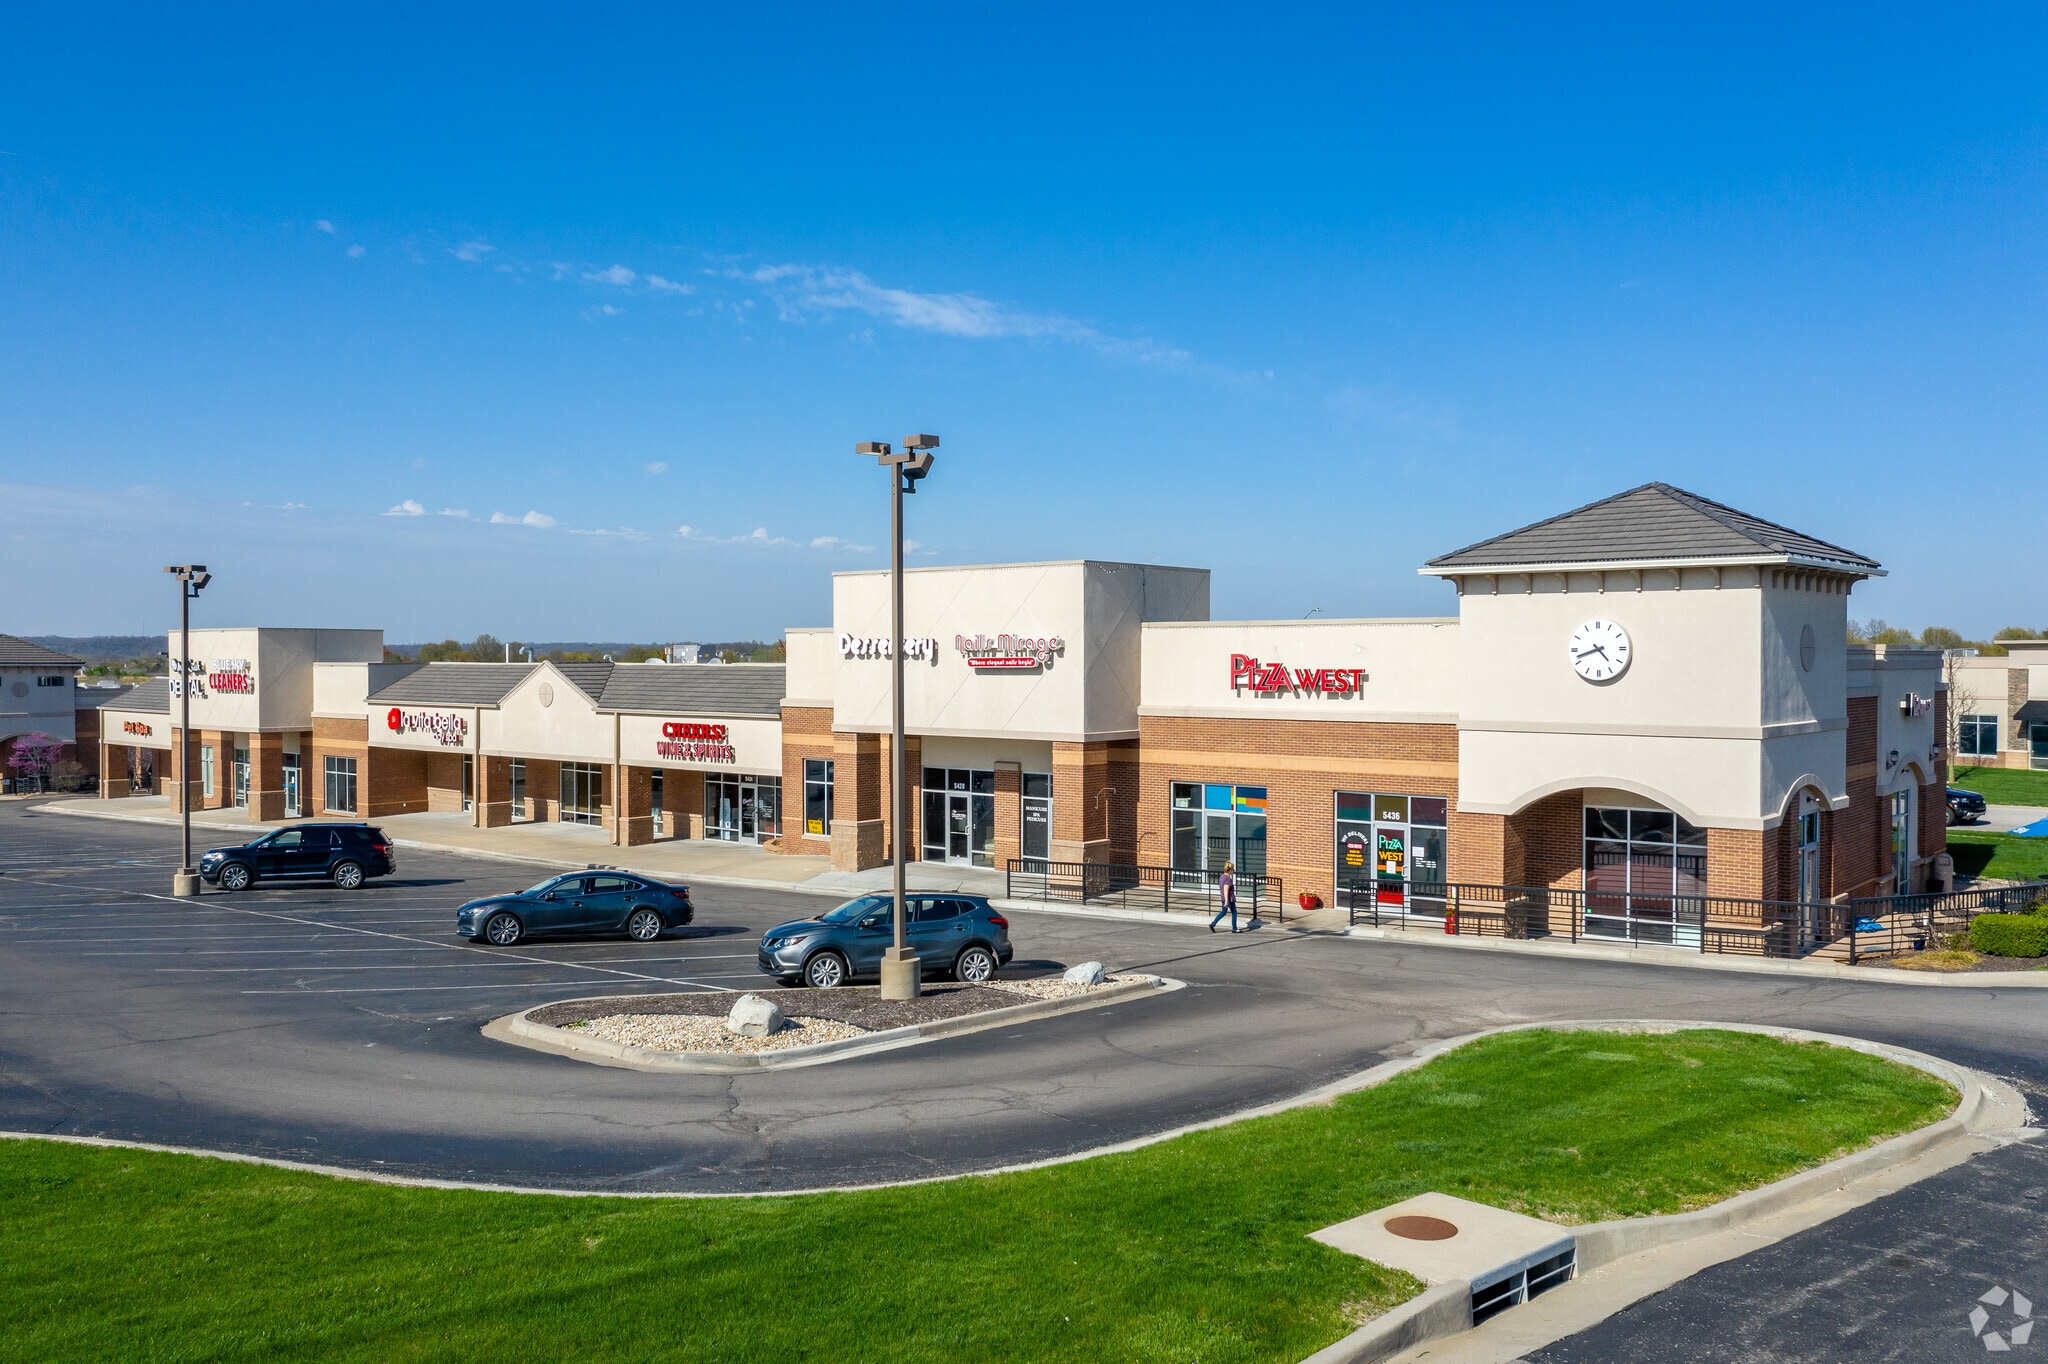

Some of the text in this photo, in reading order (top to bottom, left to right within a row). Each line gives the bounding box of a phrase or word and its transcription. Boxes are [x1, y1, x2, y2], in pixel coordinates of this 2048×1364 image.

[839, 632, 933, 661] Desserery
[169, 680, 203, 695] DETAL
[209, 673, 248, 690] CLEANERS
[1294, 668, 1364, 692] WEST
[435, 713, 461, 730] bella
[662, 722, 726, 740] CHEERS!
[656, 742, 732, 760] WINE & SPIRITS
[1383, 811, 1400, 820] 5436
[1379, 851, 1404, 862] WEST
